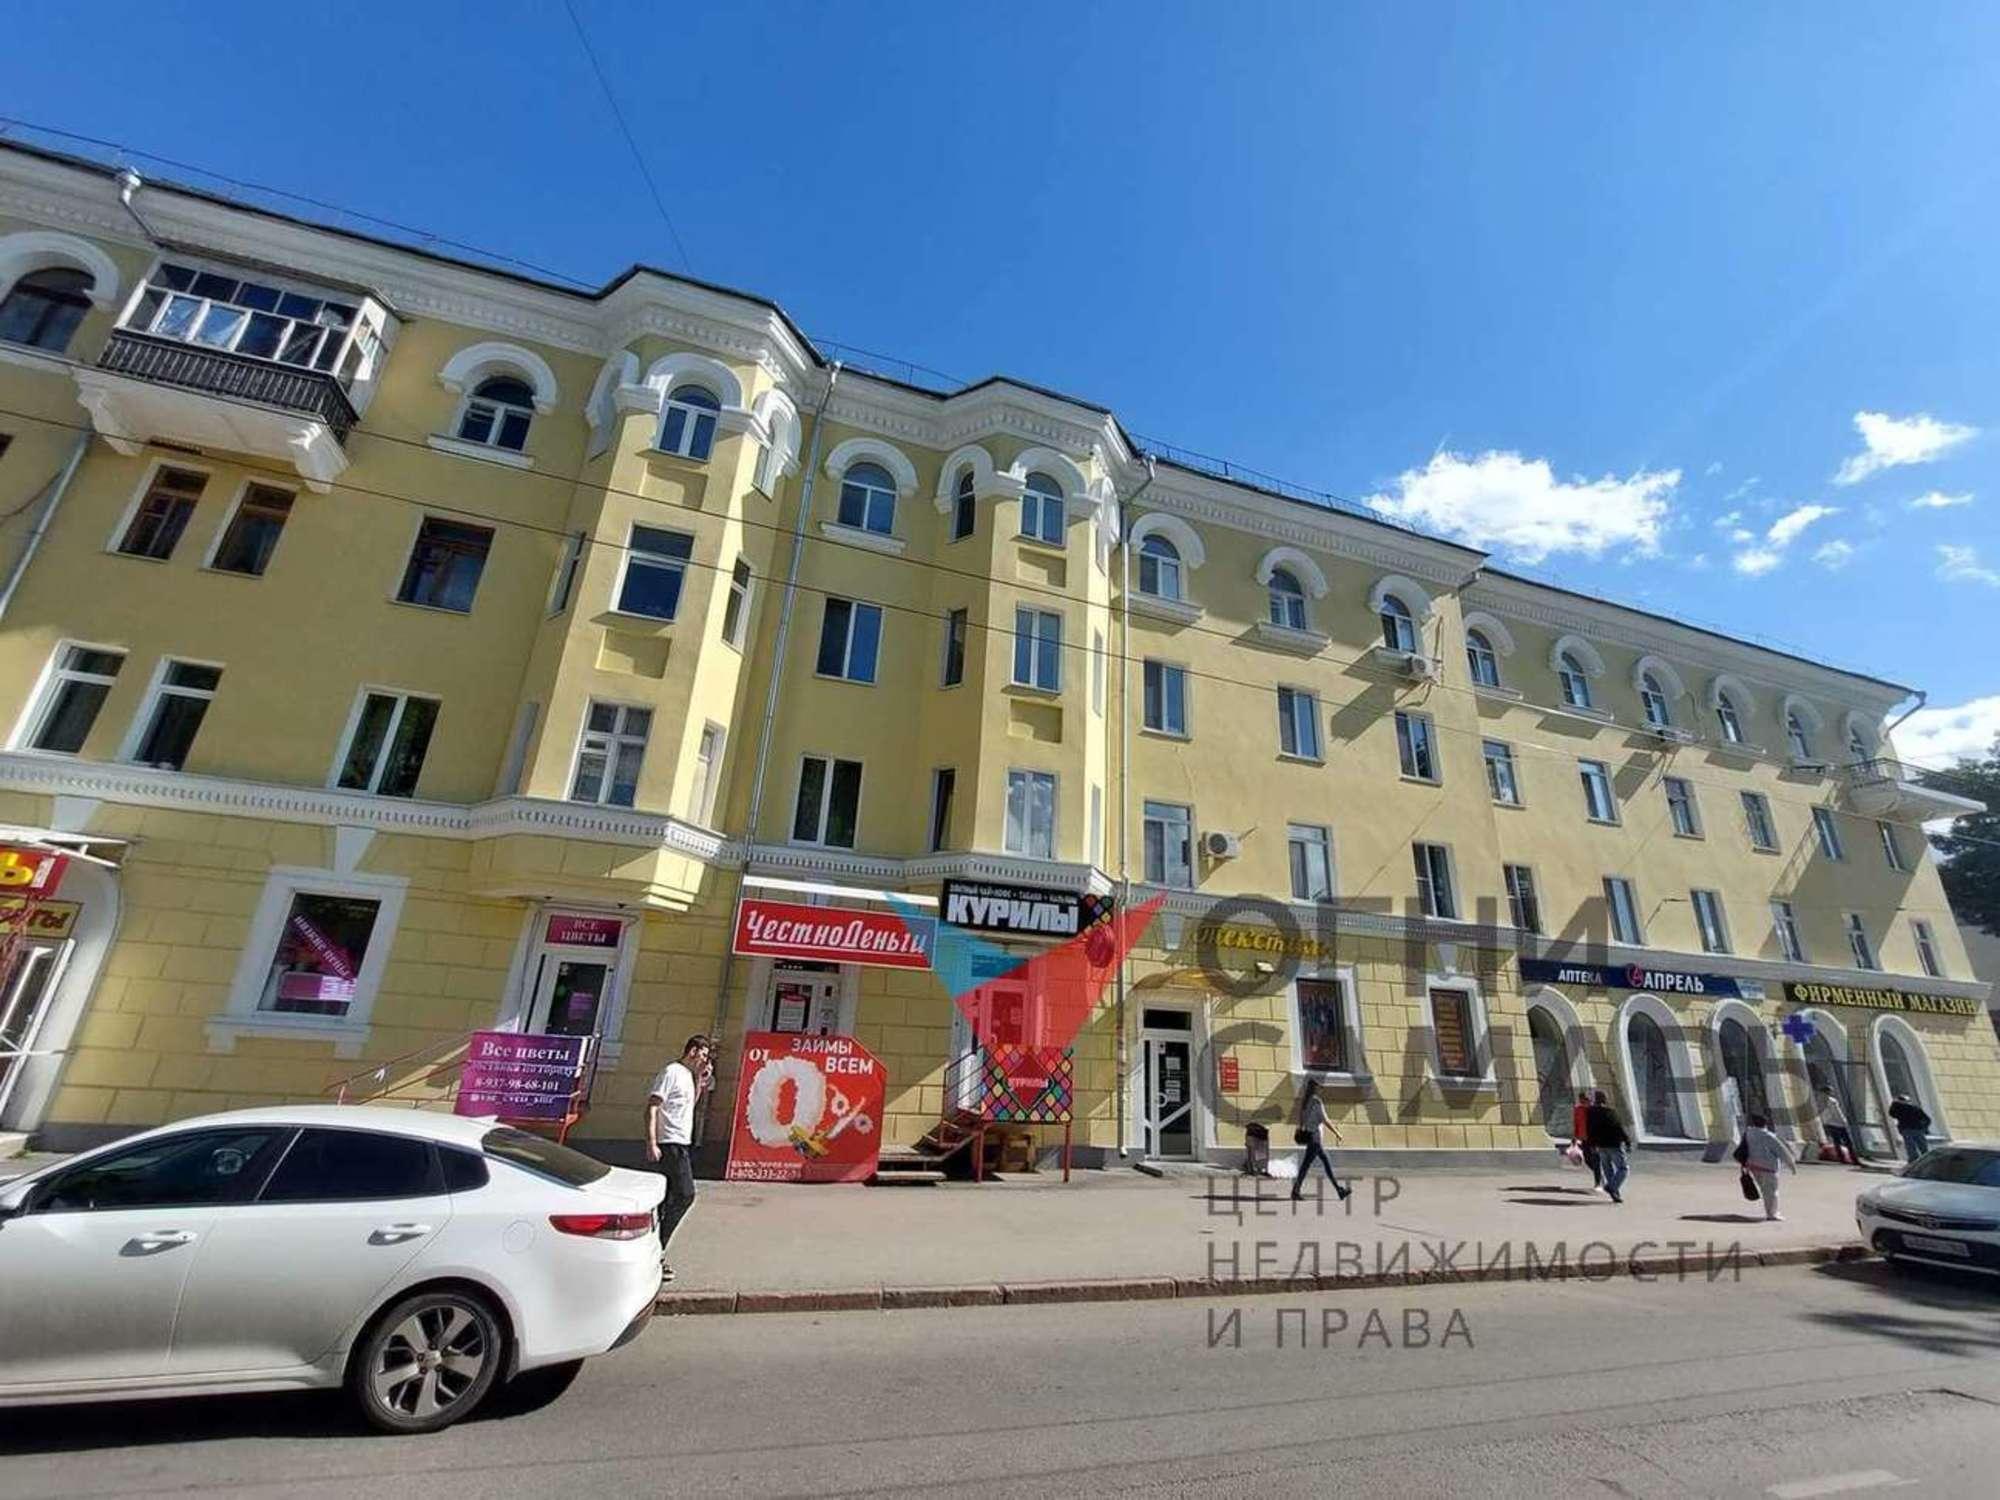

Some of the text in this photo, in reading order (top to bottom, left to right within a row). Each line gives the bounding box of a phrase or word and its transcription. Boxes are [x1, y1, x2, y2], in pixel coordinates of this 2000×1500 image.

[947, 893, 1080, 934] КУРИЛЫ
[747, 909, 927, 954] ЧестноДеньги
[1557, 968, 1604, 985] АПТЕКА
[1643, 973, 1705, 993] АПРЕЛЬ
[1794, 984, 1906, 1010] ФИРМЕННЫЙ
[1908, 994, 1979, 1015] МАГАЗИН
[481, 1041, 571, 1062] Все цветы
[825, 1056, 874, 1075] ВСЕМ
